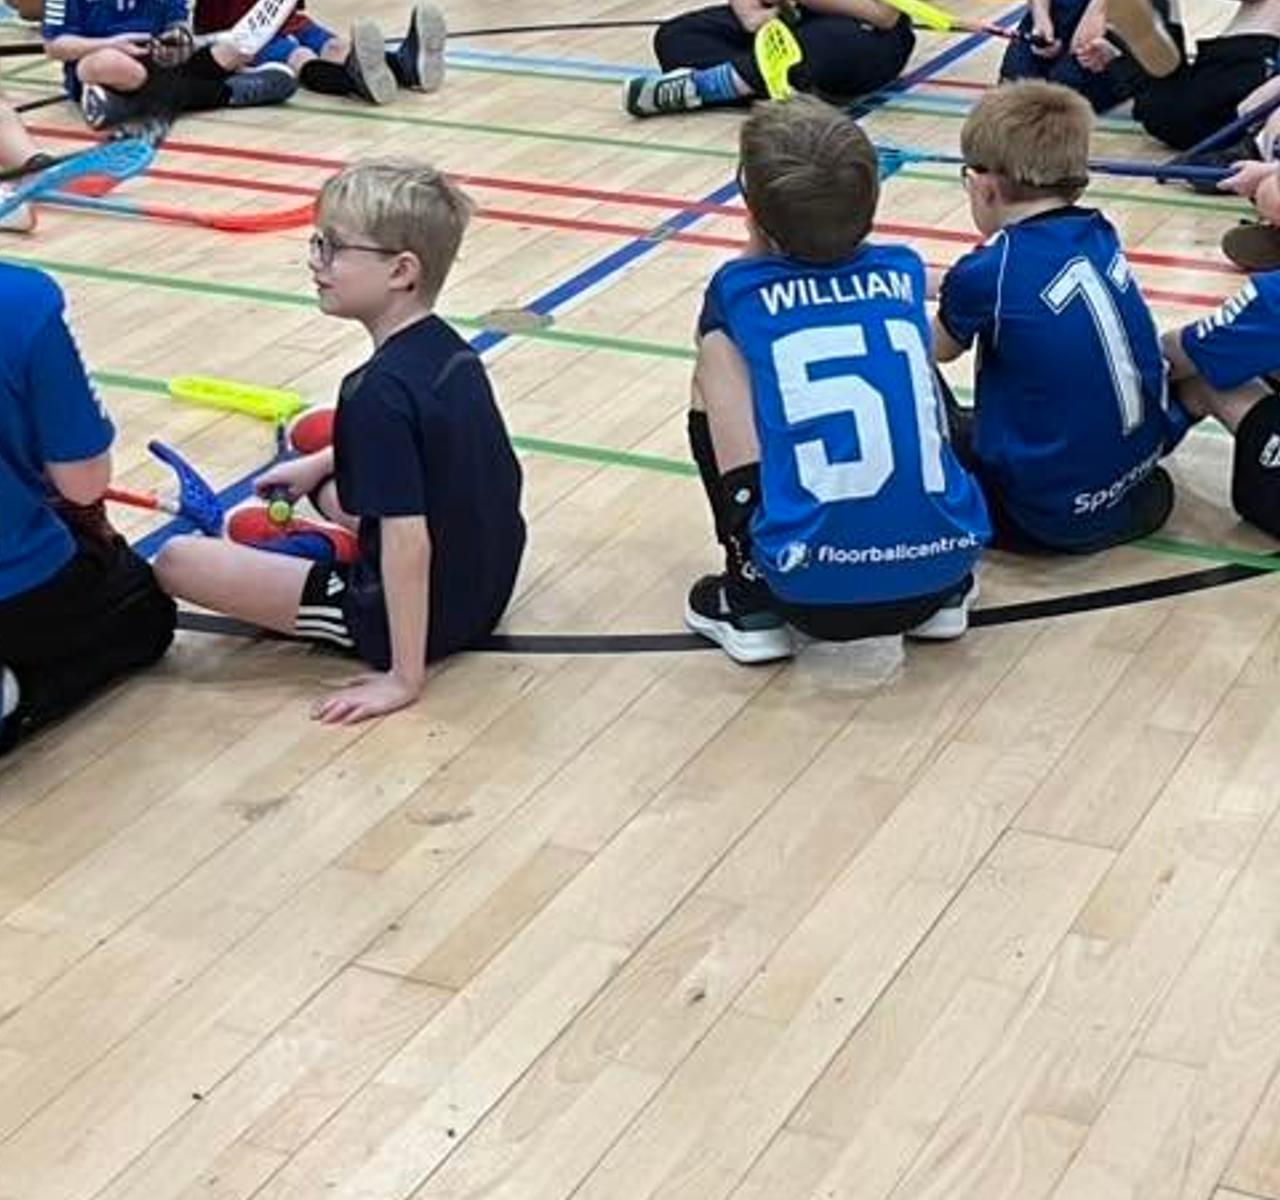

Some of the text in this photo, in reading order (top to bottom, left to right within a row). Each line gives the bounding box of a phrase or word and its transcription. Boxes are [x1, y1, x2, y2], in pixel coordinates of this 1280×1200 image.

[760, 271, 914, 316] WILLIAM
[772, 318, 946, 504] 51
[818, 532, 978, 563] floorballcentret
